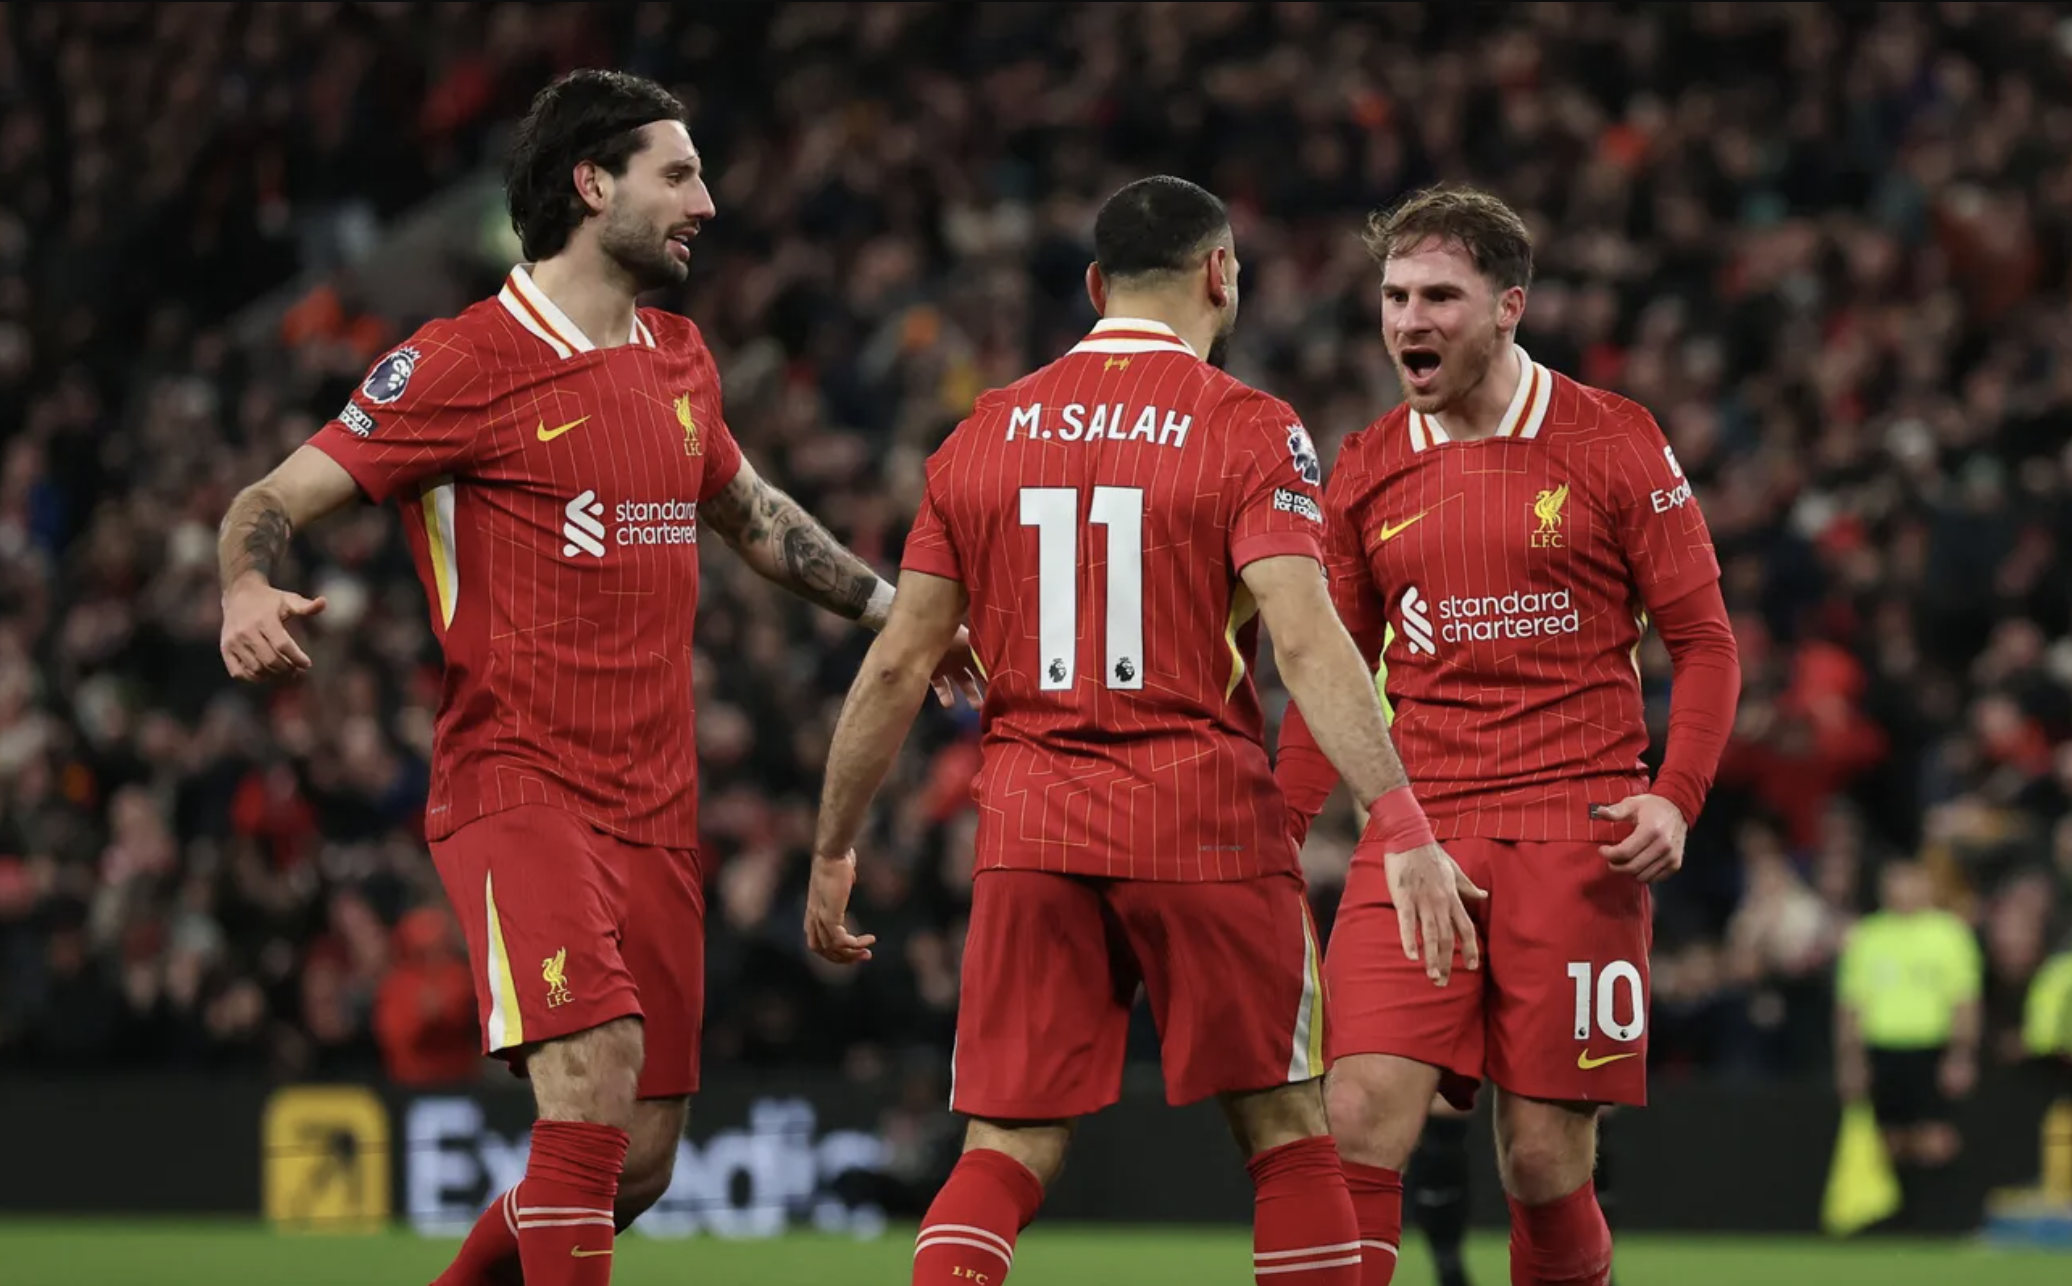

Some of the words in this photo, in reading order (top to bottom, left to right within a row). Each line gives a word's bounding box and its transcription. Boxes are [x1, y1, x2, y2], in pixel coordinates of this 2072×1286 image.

[1274, 488, 1293, 503] No
[1018, 485, 1144, 690] 11
[1439, 588, 1570, 619] standard
[1442, 609, 1580, 643] chartered
[1567, 960, 1645, 1042] 10
